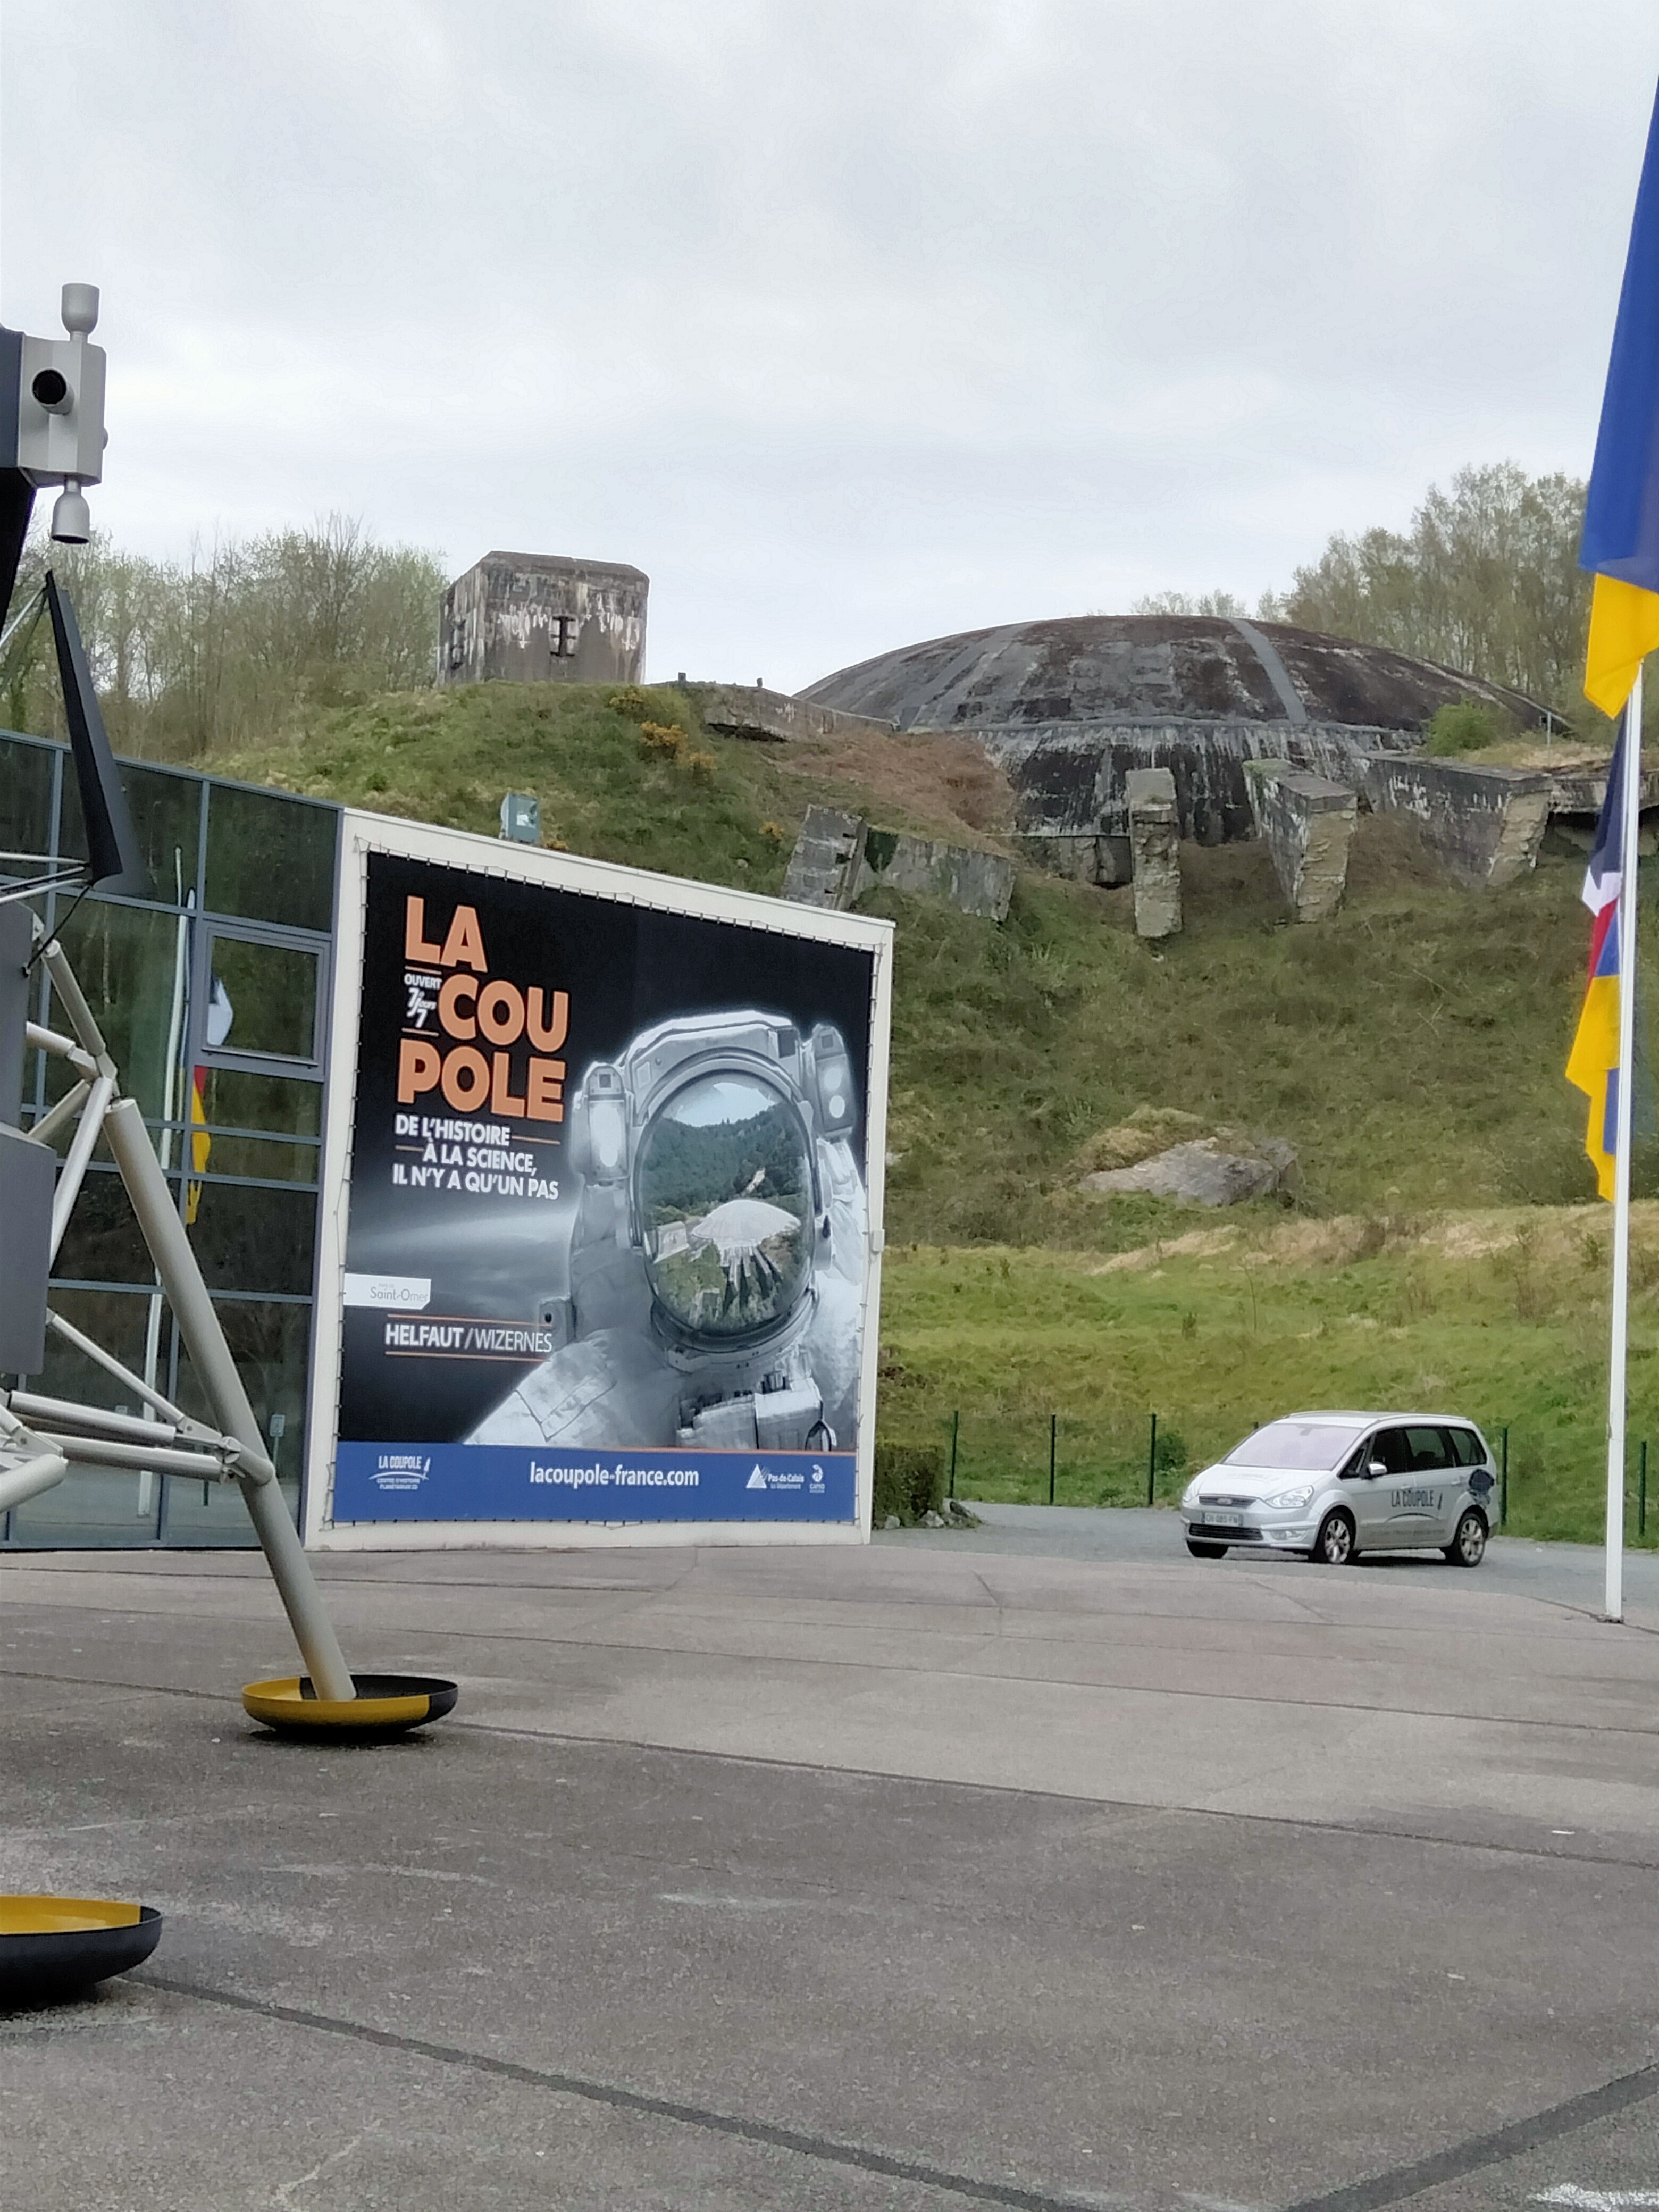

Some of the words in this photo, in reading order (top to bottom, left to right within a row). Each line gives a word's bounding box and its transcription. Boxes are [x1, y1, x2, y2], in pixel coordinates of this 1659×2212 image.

[405, 895, 488, 973] LA
[404, 973, 442, 990] OUVERT
[439, 974, 569, 1052] COU
[397, 1038, 566, 1122] POLE
[395, 1114, 418, 1136] DE
[422, 1117, 510, 1146] L'HISTOIRE
[423, 1138, 437, 1163] À
[441, 1144, 463, 1165] LA
[466, 1145, 537, 1176] SCIENCE,
[392, 1163, 408, 1184] IL
[410, 1166, 446, 1188] N'Y
[447, 1170, 462, 1190] A
[465, 1172, 524, 1196] QU'UN
[528, 1179, 558, 1200] PAS
[378, 1455, 388, 1469] LA
[390, 1456, 422, 1469] COUPOLE
[530, 1462, 699, 1489] lacoupole-france.com
[1391, 1490, 1401, 1507] LA
[1402, 1490, 1434, 1507] COUPOLE
